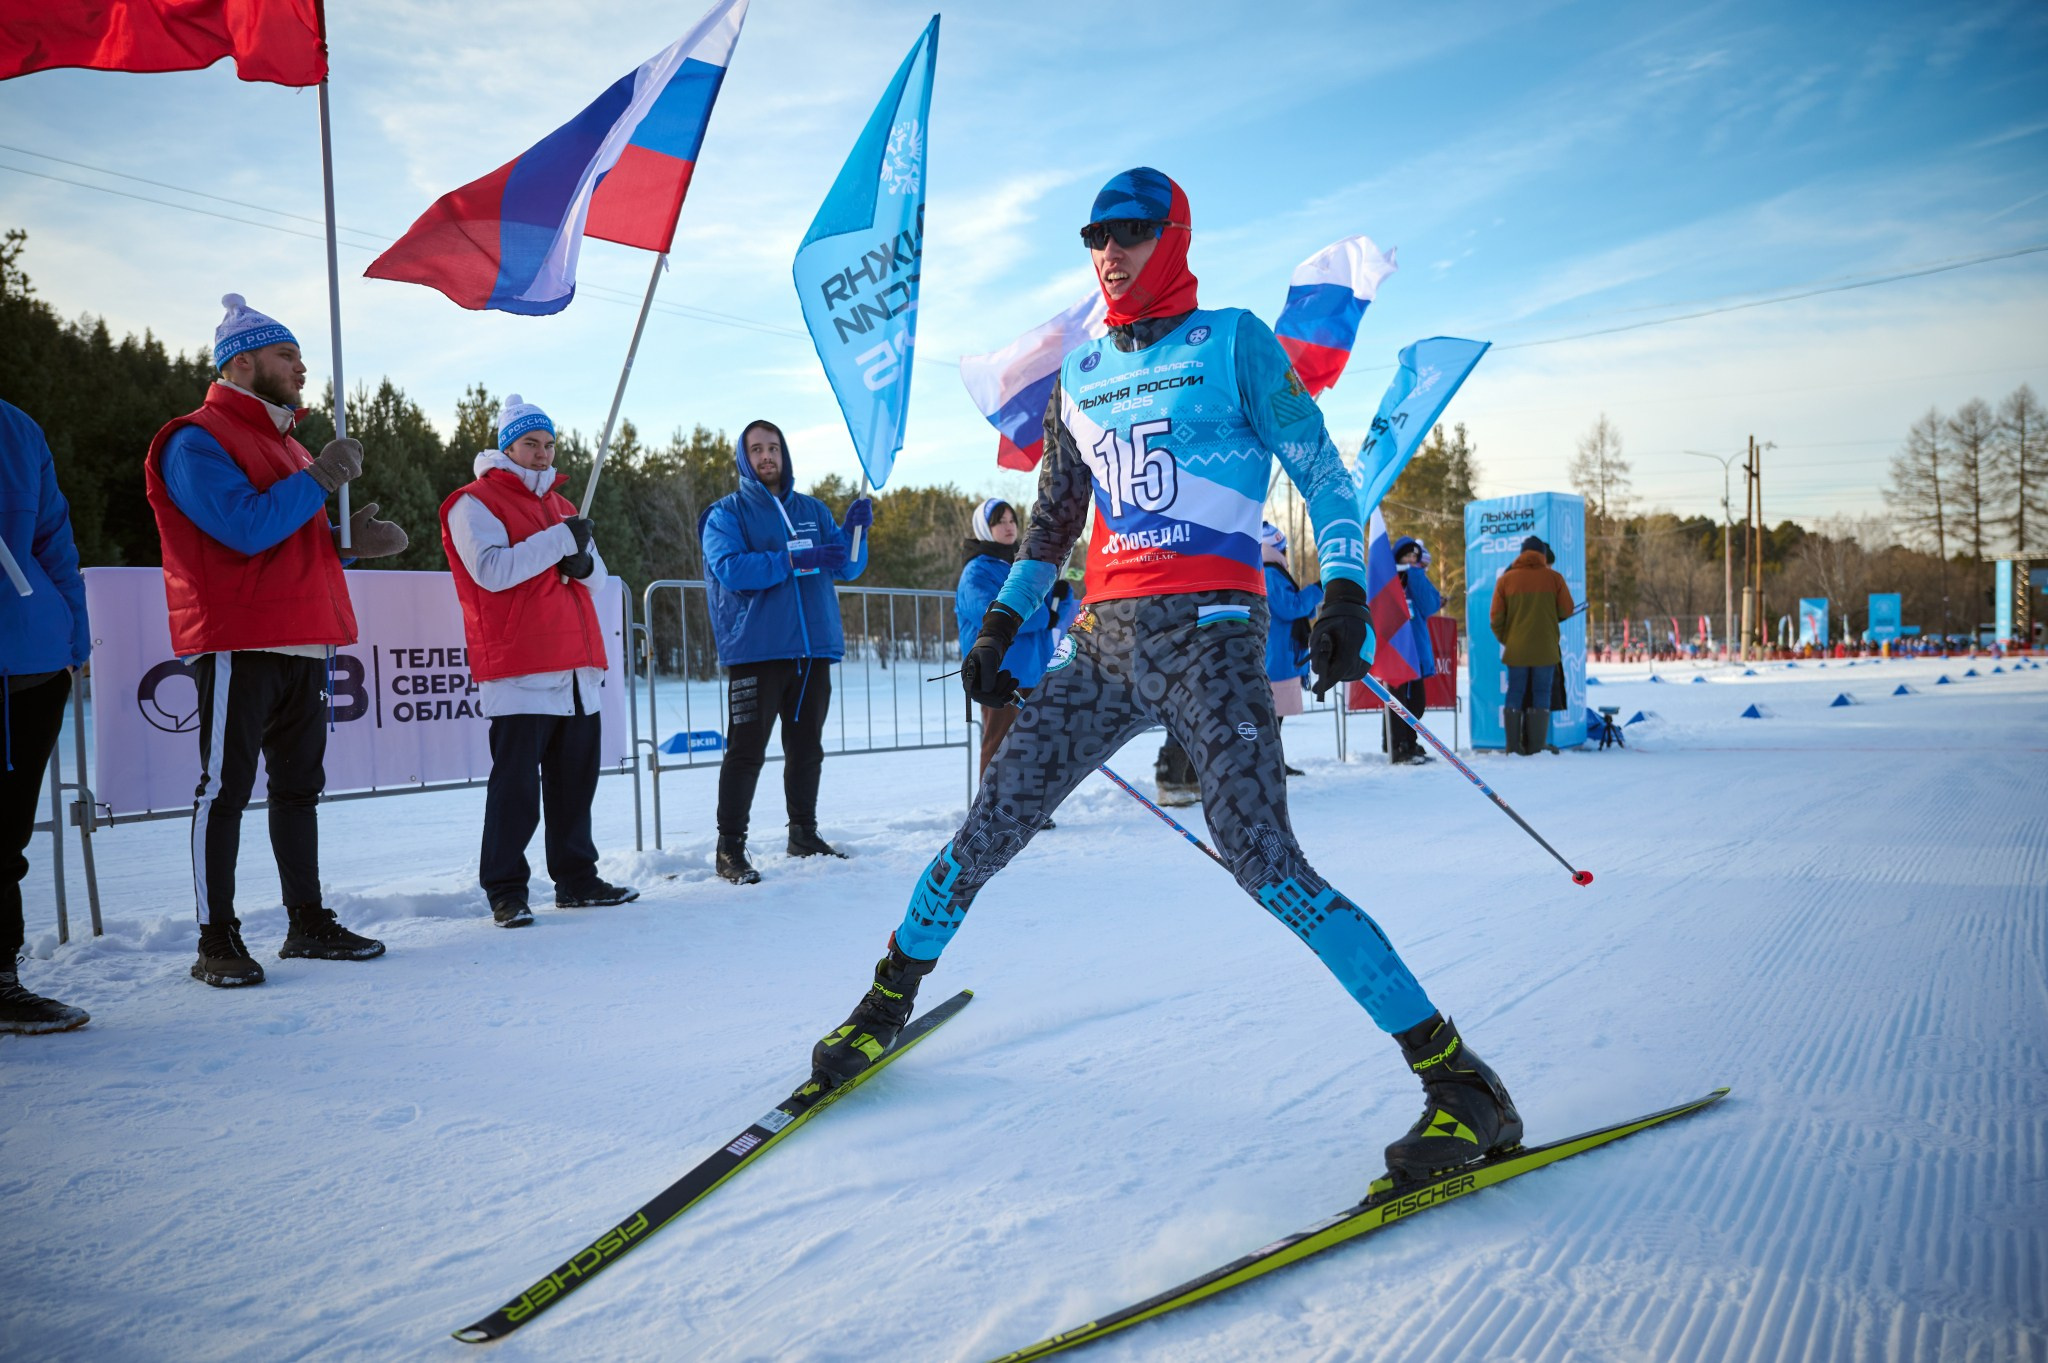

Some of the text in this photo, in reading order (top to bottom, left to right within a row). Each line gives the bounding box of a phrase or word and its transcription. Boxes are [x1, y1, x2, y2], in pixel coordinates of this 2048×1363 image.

[246, 329, 290, 344] РОССИ
[1079, 360, 1204, 394] СВЕРДЛОВСКАЯ ОБЛАСТЬ
[1077, 375, 1204, 412] ЛЫЖНЯ РОССИИ
[1111, 394, 1154, 415] 2025
[508, 417, 550, 436] РОССИИ
[1092, 417, 1178, 519] 15
[1480, 508, 1535, 523] ЛЫЖНЯ
[1480, 521, 1536, 535] РОССИИ
[1481, 535, 1530, 554] 202
[389, 648, 469, 669] ТЕЛЕ
[1435, 657, 1452, 674] МС
[391, 674, 479, 696] СВЕРД
[1412, 1036, 1459, 1070] FISCHER
[1381, 1174, 1476, 1223] FISCHER
[501, 1211, 650, 1322] FISCHER
